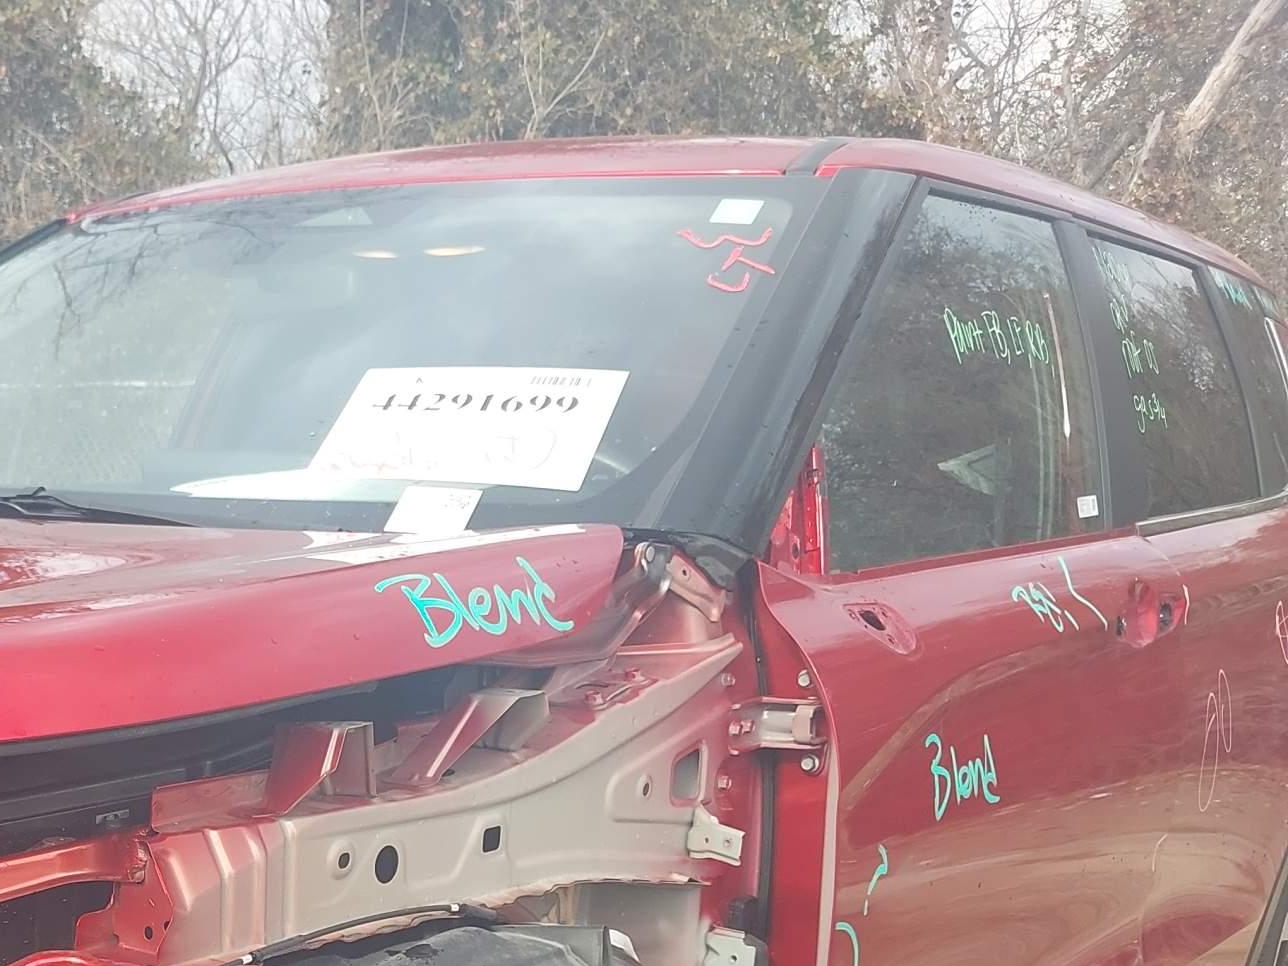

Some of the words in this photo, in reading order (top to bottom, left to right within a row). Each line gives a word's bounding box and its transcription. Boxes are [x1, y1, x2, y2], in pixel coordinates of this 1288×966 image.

[372, 392, 580, 414] 44291699
[374, 556, 575, 648] Blend
[924, 733, 1001, 822] Blend
